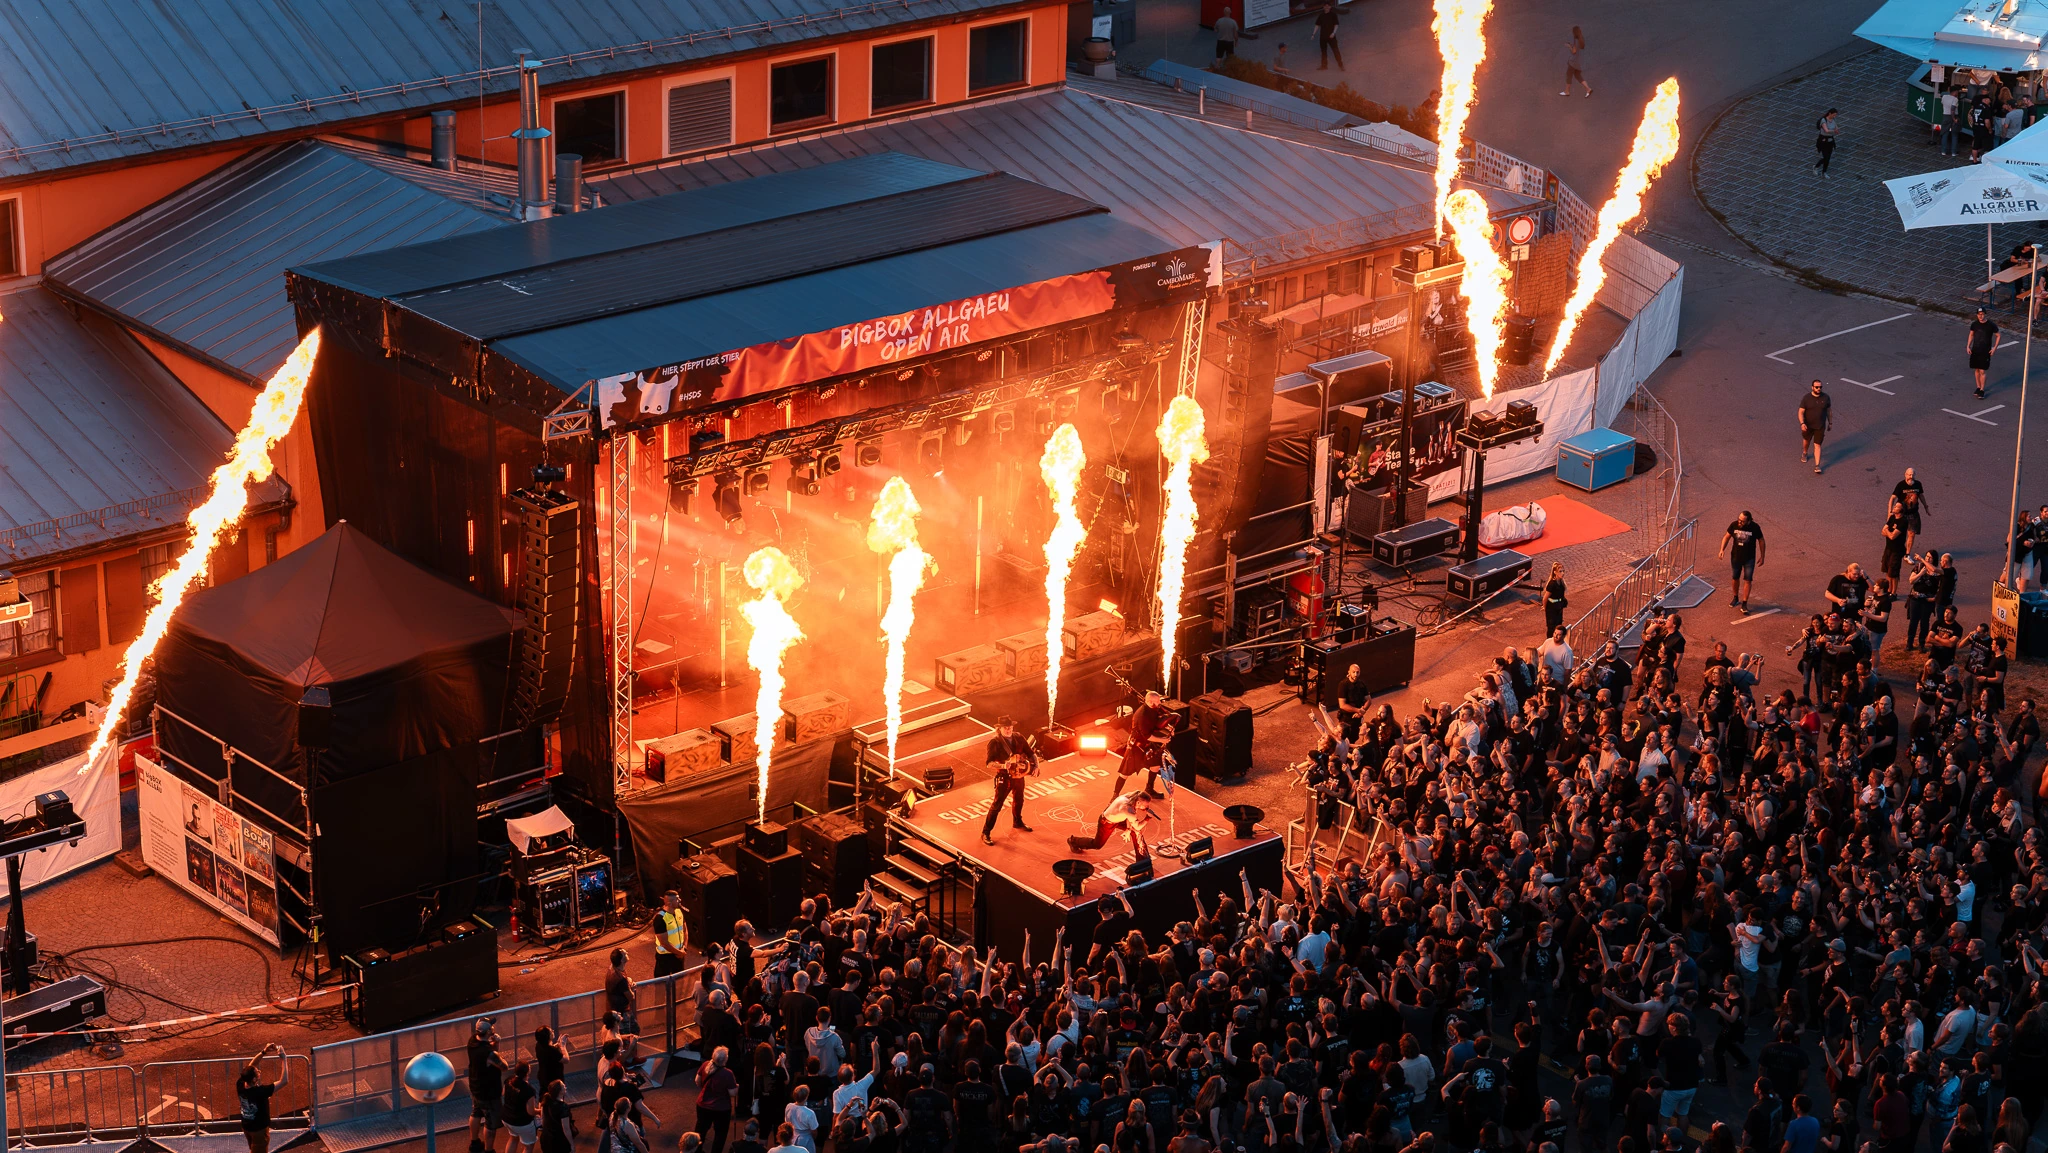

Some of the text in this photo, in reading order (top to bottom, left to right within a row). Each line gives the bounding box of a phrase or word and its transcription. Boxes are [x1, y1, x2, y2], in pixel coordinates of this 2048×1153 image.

[1960, 199, 2040, 216] ALLGÄUER
[1976, 207, 2027, 215] BRAUHAUS
[1132, 263, 1152, 272] POWERED
[840, 292, 1010, 350] BIGBOX ALLGAEU
[880, 323, 971, 361] OPEN AIR
[662, 351, 740, 376] HIER STEPPT DER STIER
[678, 389, 702, 402] #HSDS
[1385, 446, 1416, 461] Stae
[1385, 456, 1415, 471] Teas
[1992, 616, 2017, 637] KEMPTEN
